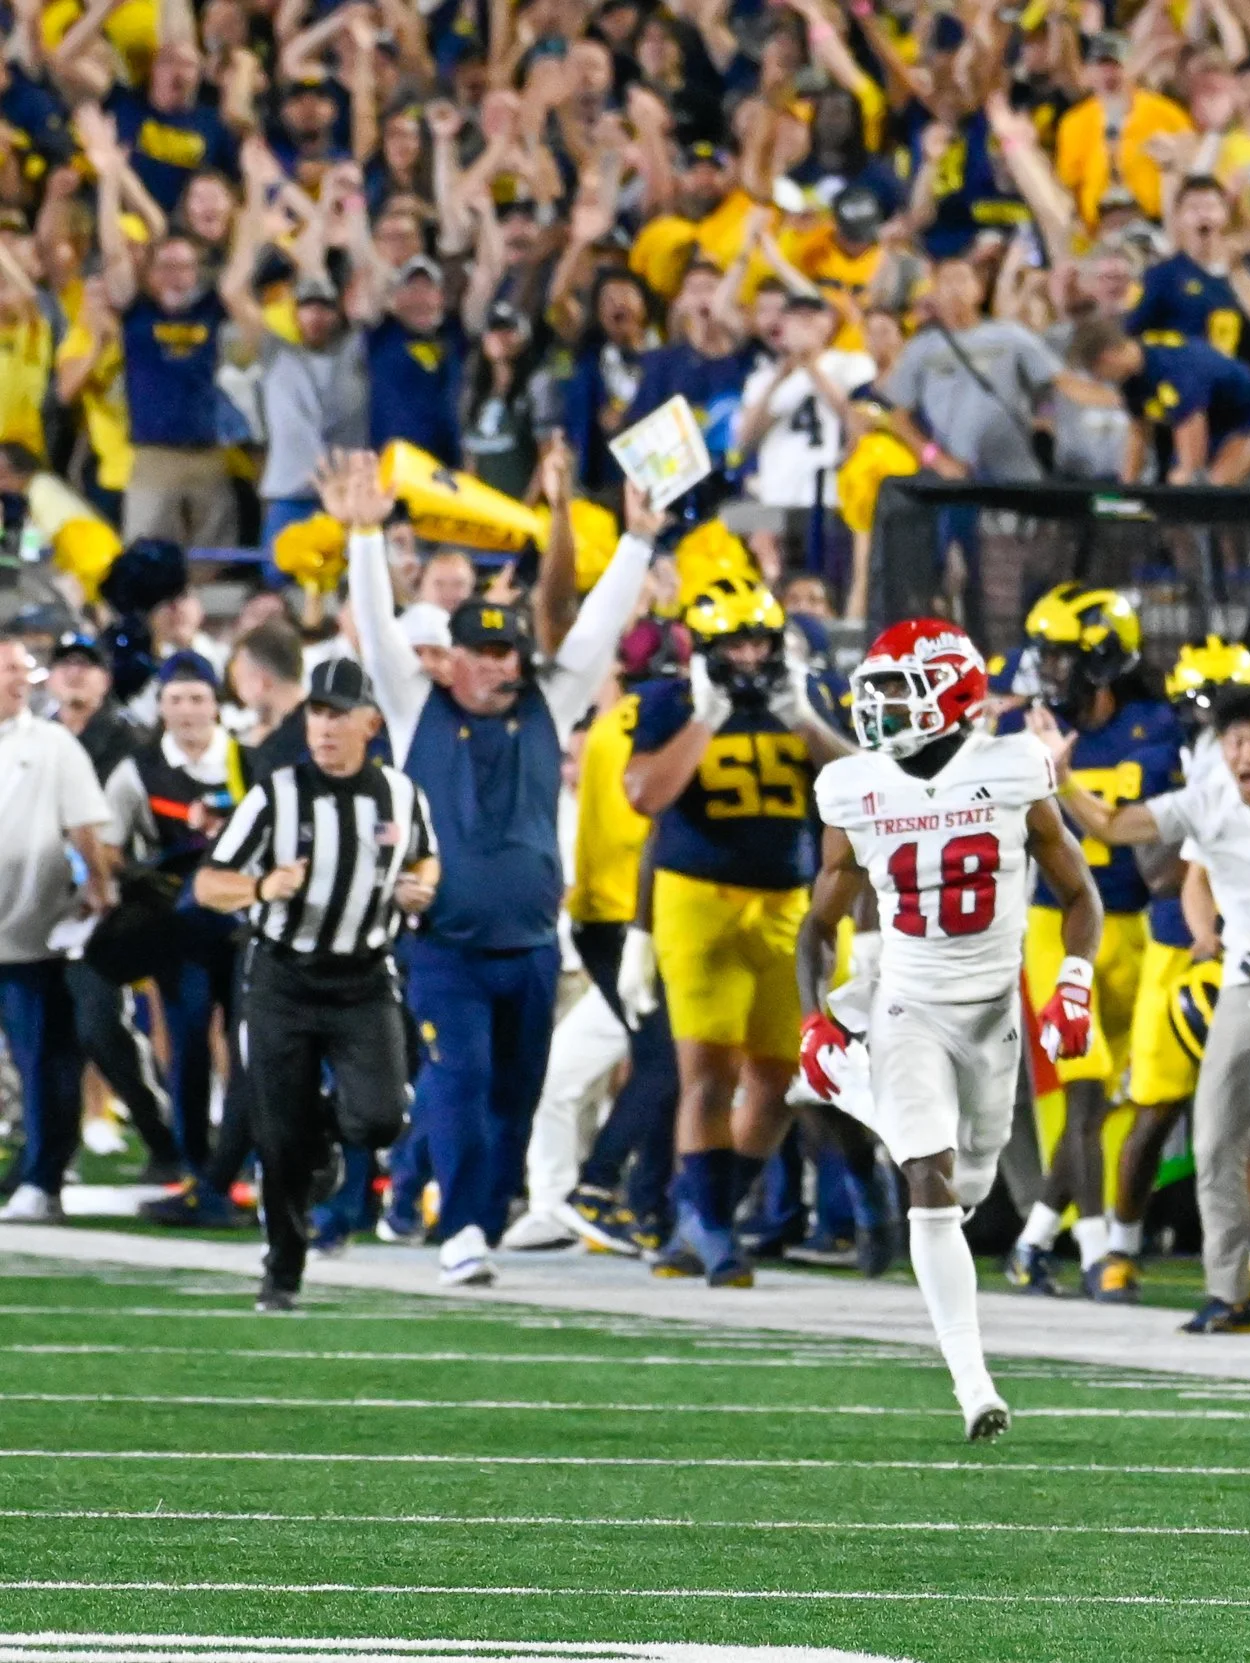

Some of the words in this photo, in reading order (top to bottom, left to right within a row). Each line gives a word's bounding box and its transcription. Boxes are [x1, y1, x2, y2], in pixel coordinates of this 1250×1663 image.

[791, 394, 823, 448] 4
[700, 732, 808, 819] 55
[874, 815, 940, 836] FRESNO
[945, 806, 995, 828] STATE
[887, 832, 999, 937] 18
